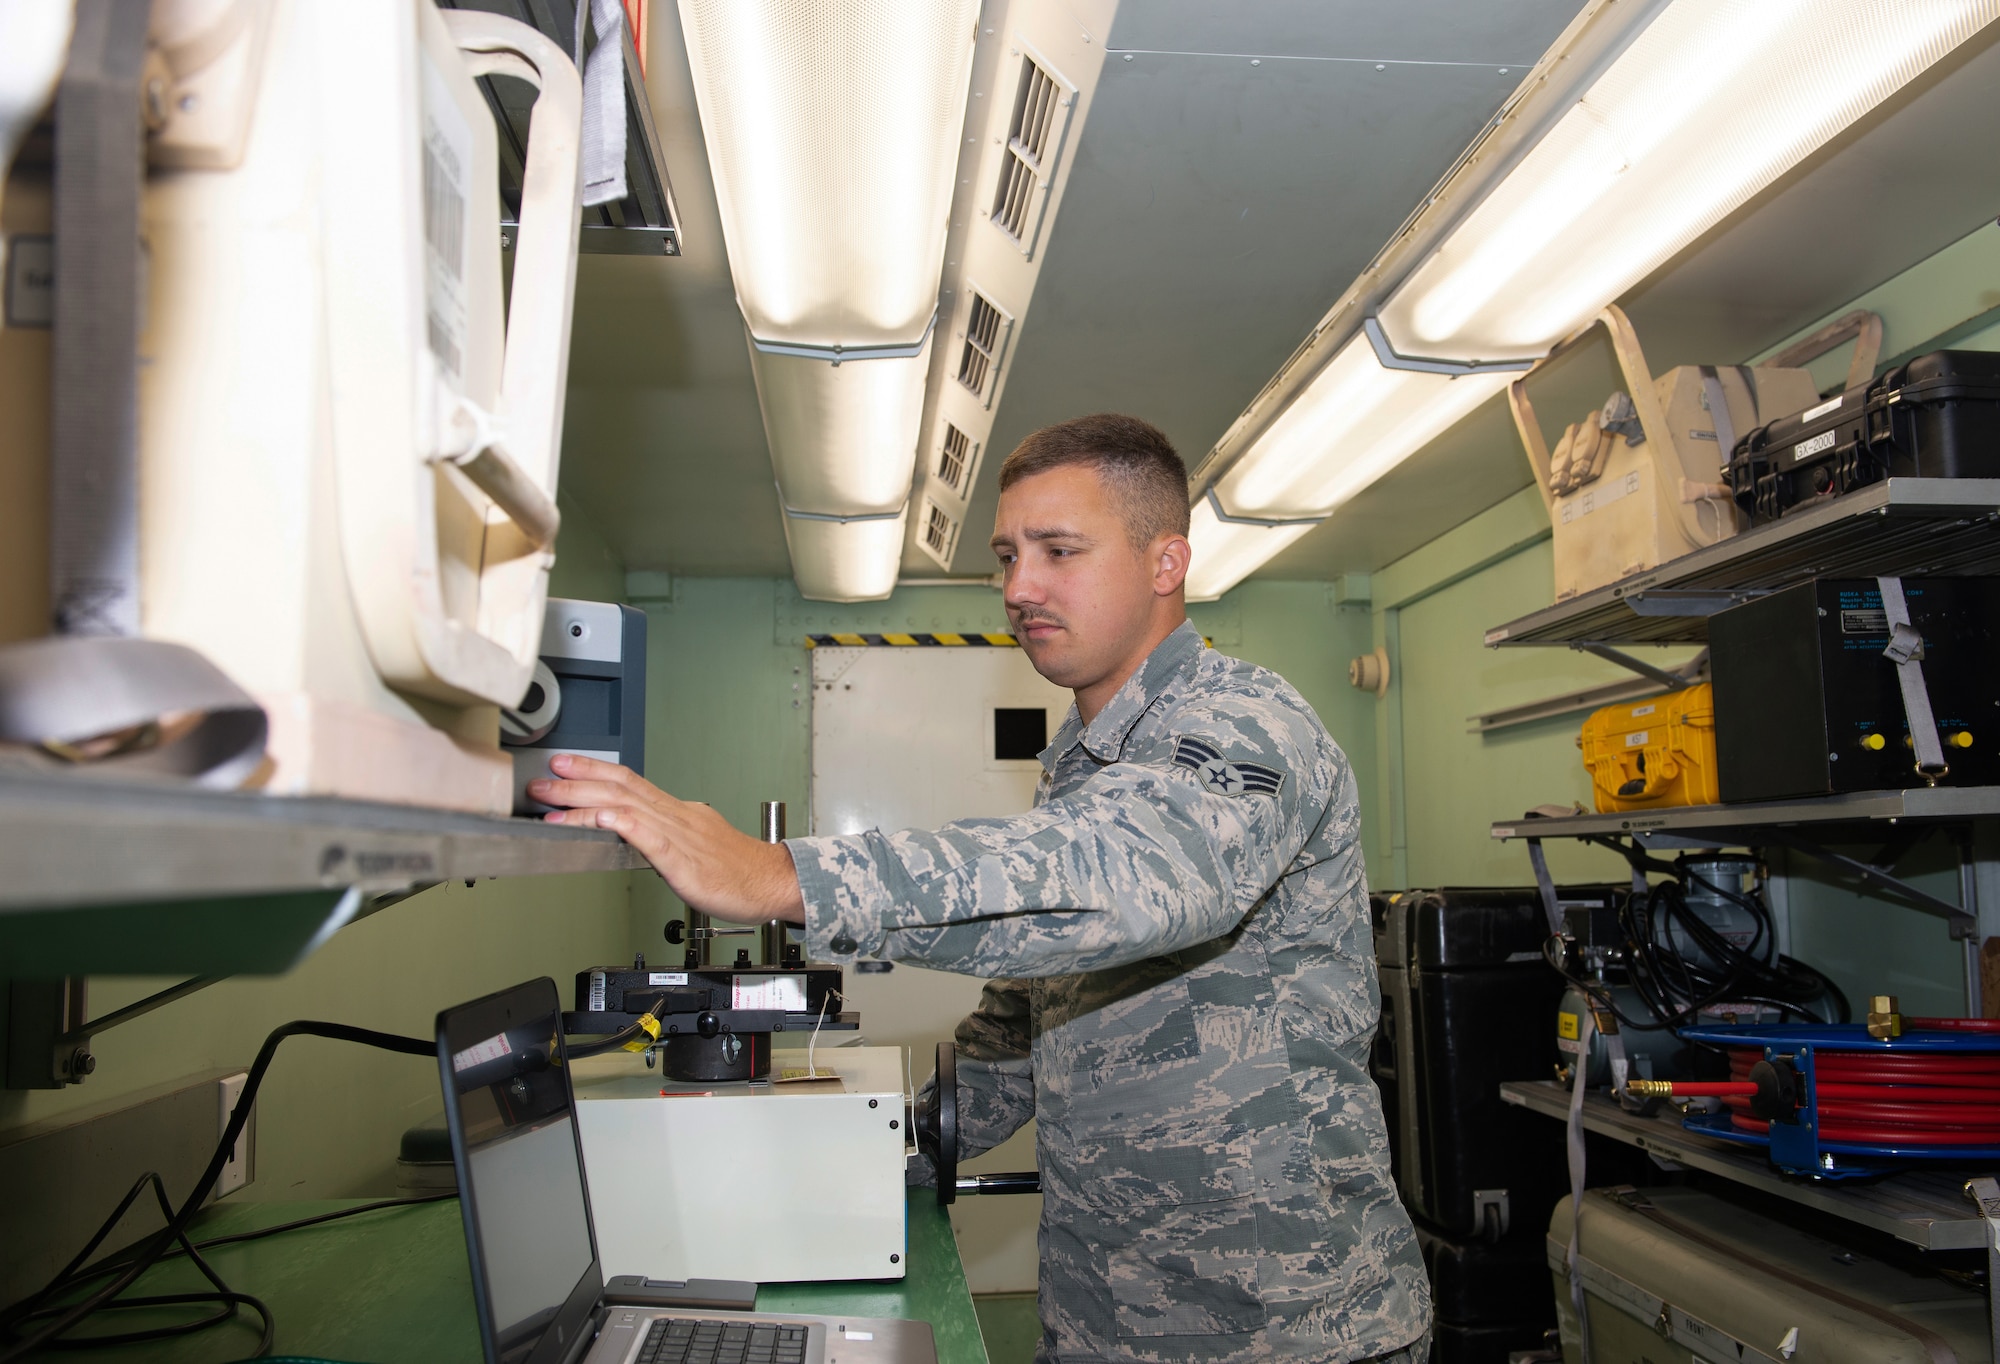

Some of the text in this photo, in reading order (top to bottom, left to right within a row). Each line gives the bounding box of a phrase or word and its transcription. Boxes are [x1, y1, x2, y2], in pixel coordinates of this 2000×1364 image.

[1796, 432, 1834, 458] GX-2000
[733, 976, 741, 1009] Snap-on
[1686, 1319, 1704, 1337] FRONT
